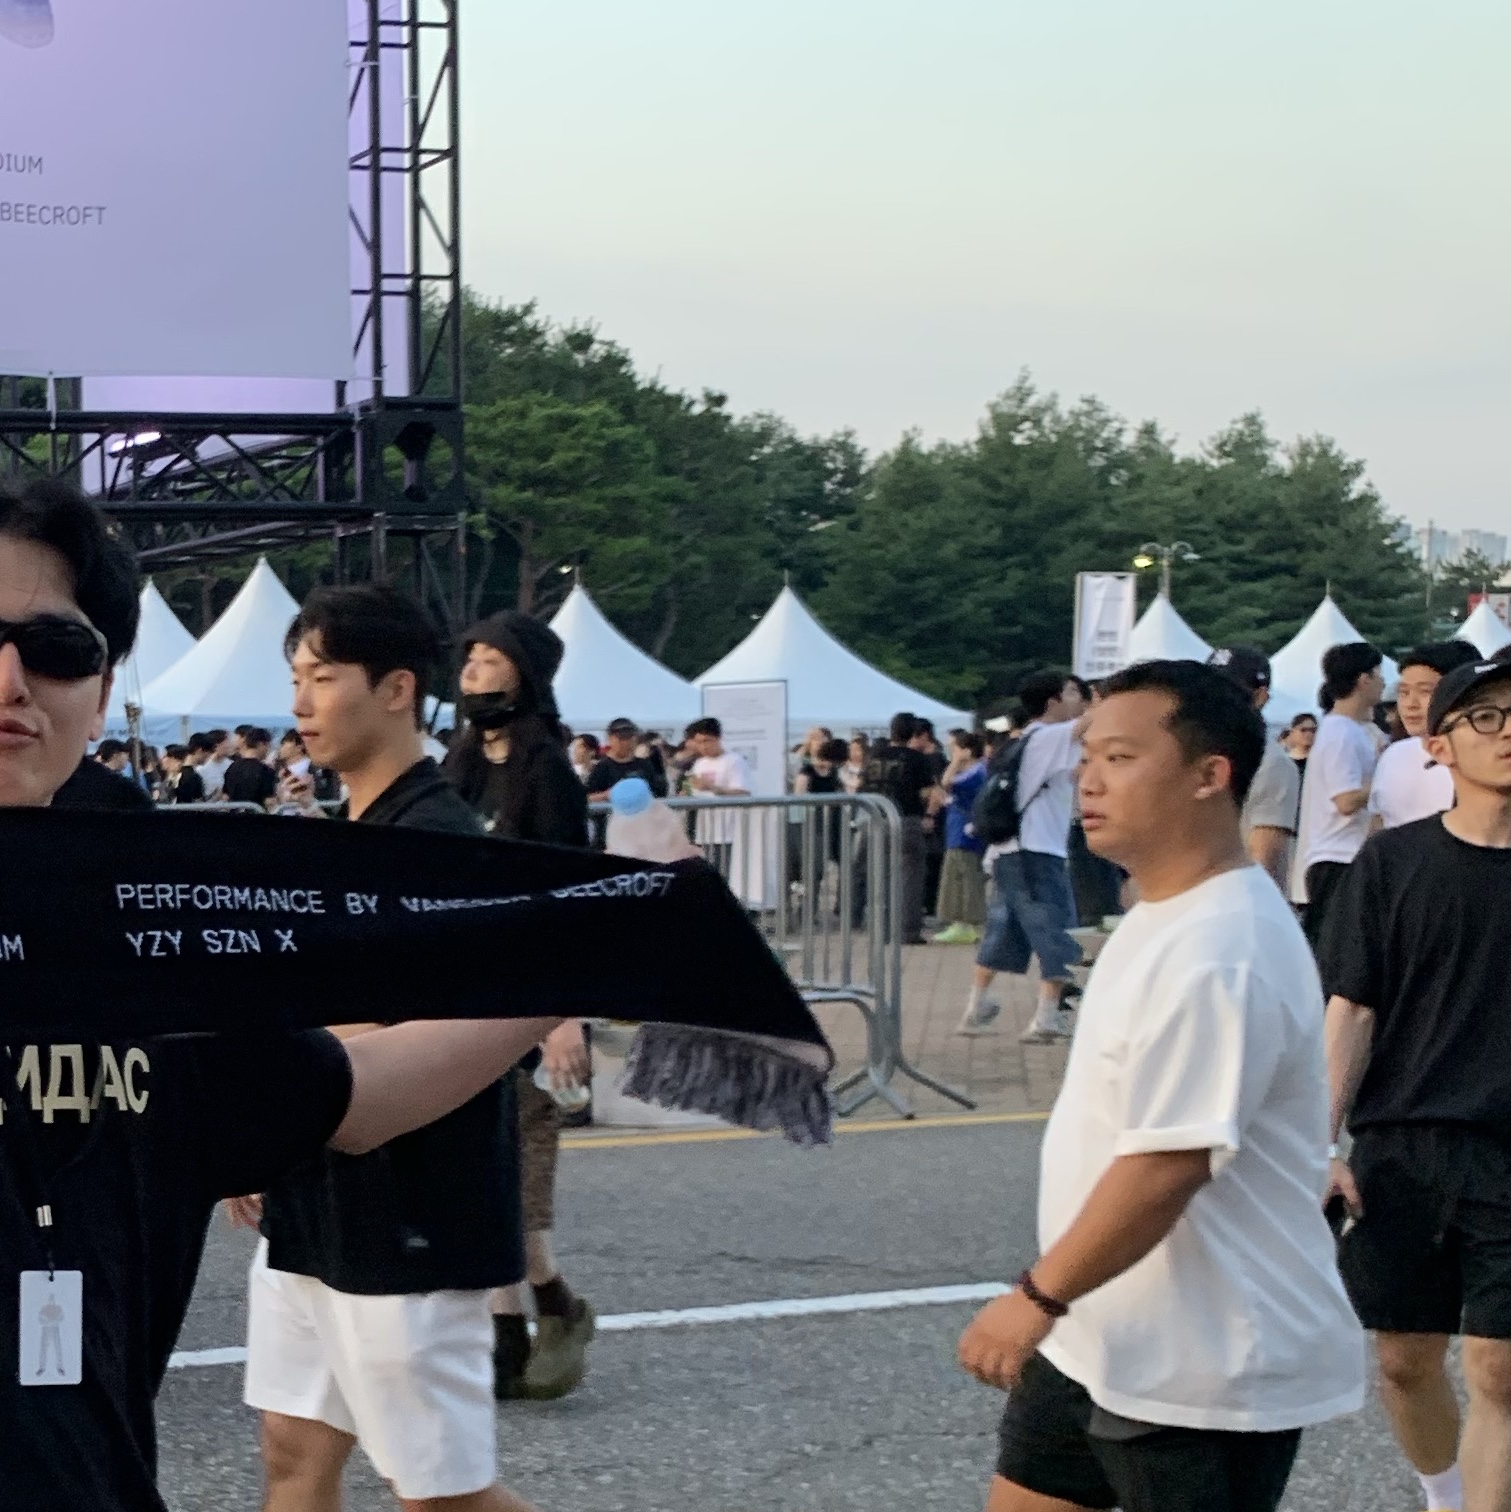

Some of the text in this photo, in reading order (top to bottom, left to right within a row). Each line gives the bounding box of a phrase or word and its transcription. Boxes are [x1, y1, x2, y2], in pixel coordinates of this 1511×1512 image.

[0, 202, 107, 226] BEECROFT
[116, 883, 326, 915] PERFORMANCE
[345, 892, 379, 915] BY
[126, 929, 298, 958] YZY SZN X
